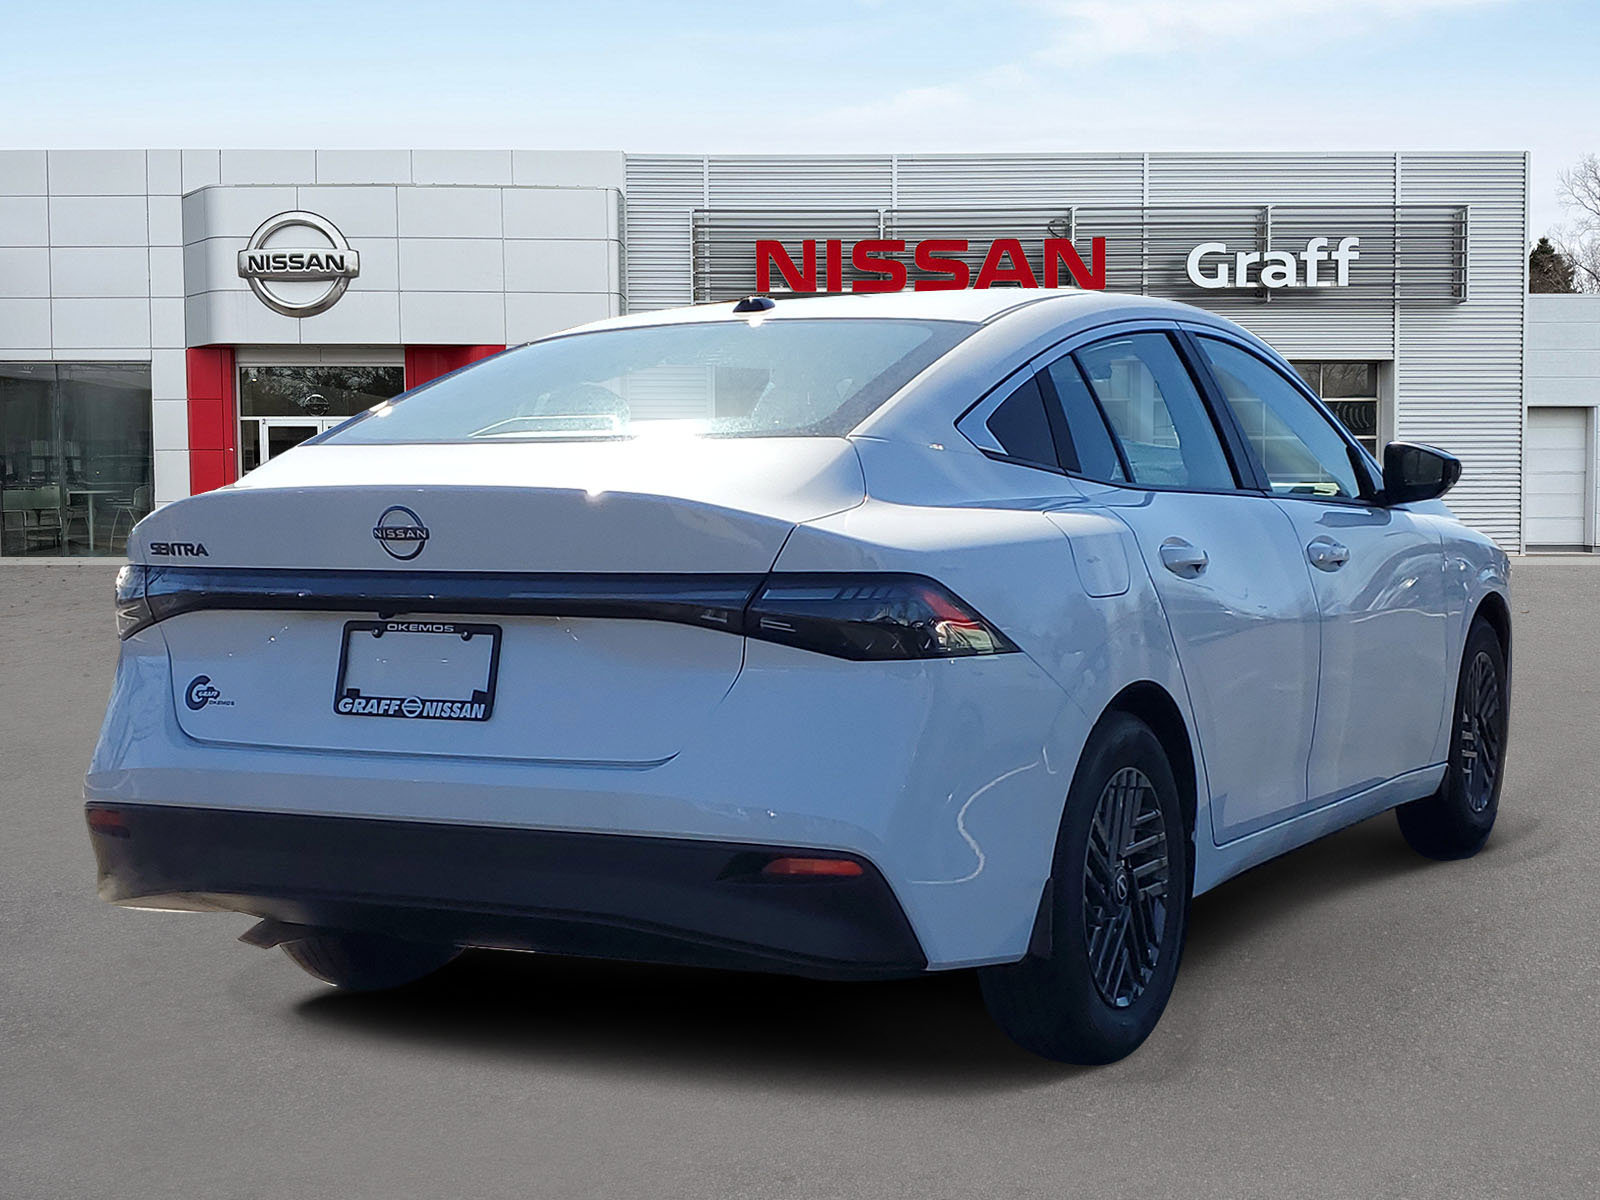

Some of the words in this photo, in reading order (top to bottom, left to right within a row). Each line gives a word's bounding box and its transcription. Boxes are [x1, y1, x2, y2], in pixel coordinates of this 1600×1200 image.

[247, 253, 345, 272] NISSAN
[755, 237, 1106, 292] NISSAN
[1187, 237, 1360, 289] Graff
[374, 528, 428, 539] NISSAN
[150, 542, 209, 557] SENTRA
[387, 623, 454, 633] OKEMOS
[338, 697, 401, 715] GRAFF
[422, 701, 486, 719] NISSAN
